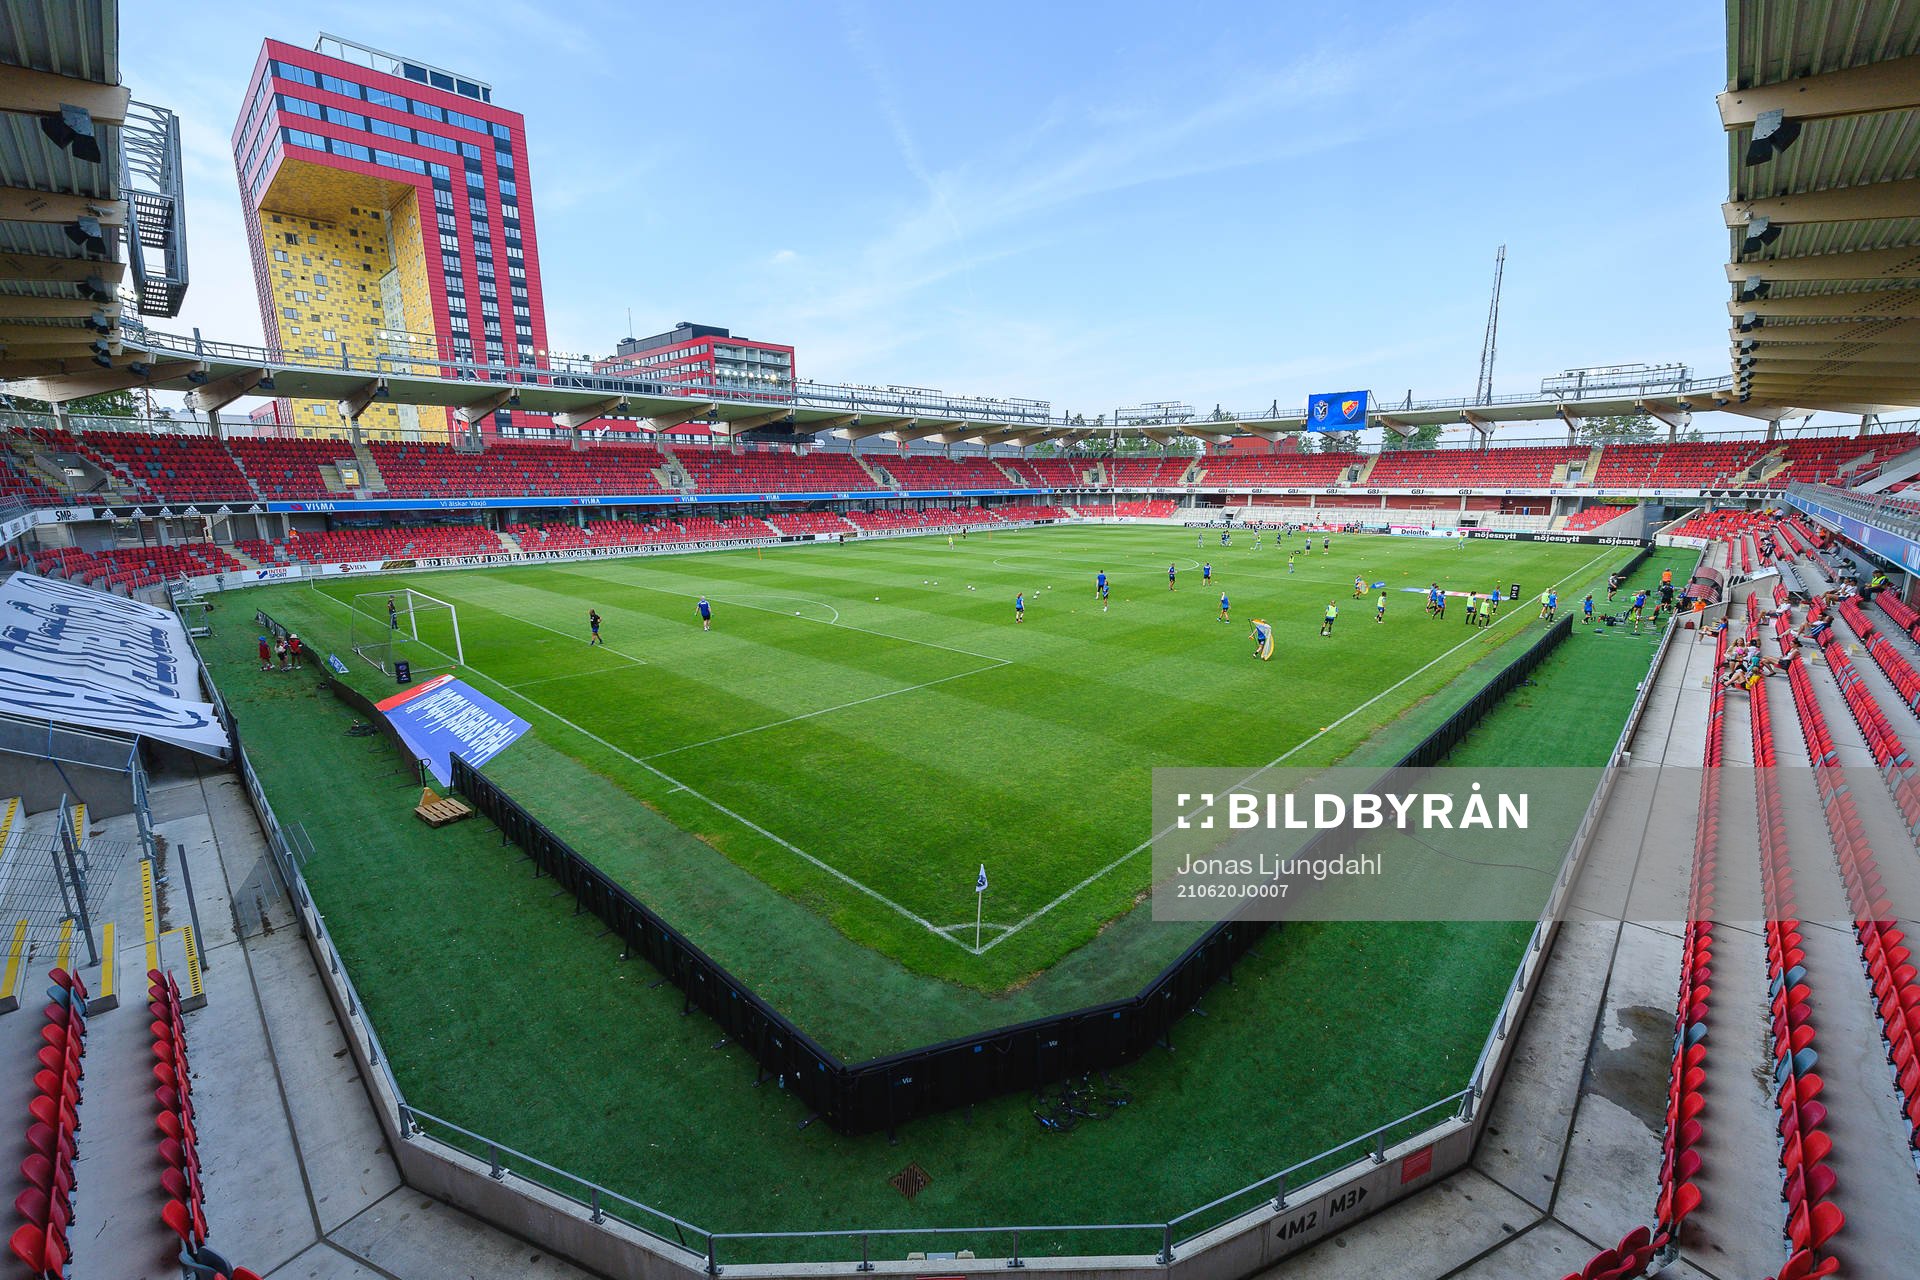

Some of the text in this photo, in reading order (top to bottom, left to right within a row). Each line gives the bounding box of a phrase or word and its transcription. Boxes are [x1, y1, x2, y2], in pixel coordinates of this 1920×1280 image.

[305, 503, 335, 511] VISMA
[1401, 528, 1430, 536] Deloitte
[1474, 532, 1517, 540] nöjesnytt
[1533, 534, 1580, 543] nöjesnytt
[415, 559, 439, 568] MED
[490, 554, 510, 563] DEN
[431, 704, 497, 742] svensk
[460, 719, 517, 767] Heja
[1288, 1191, 1357, 1239] M2 M3
